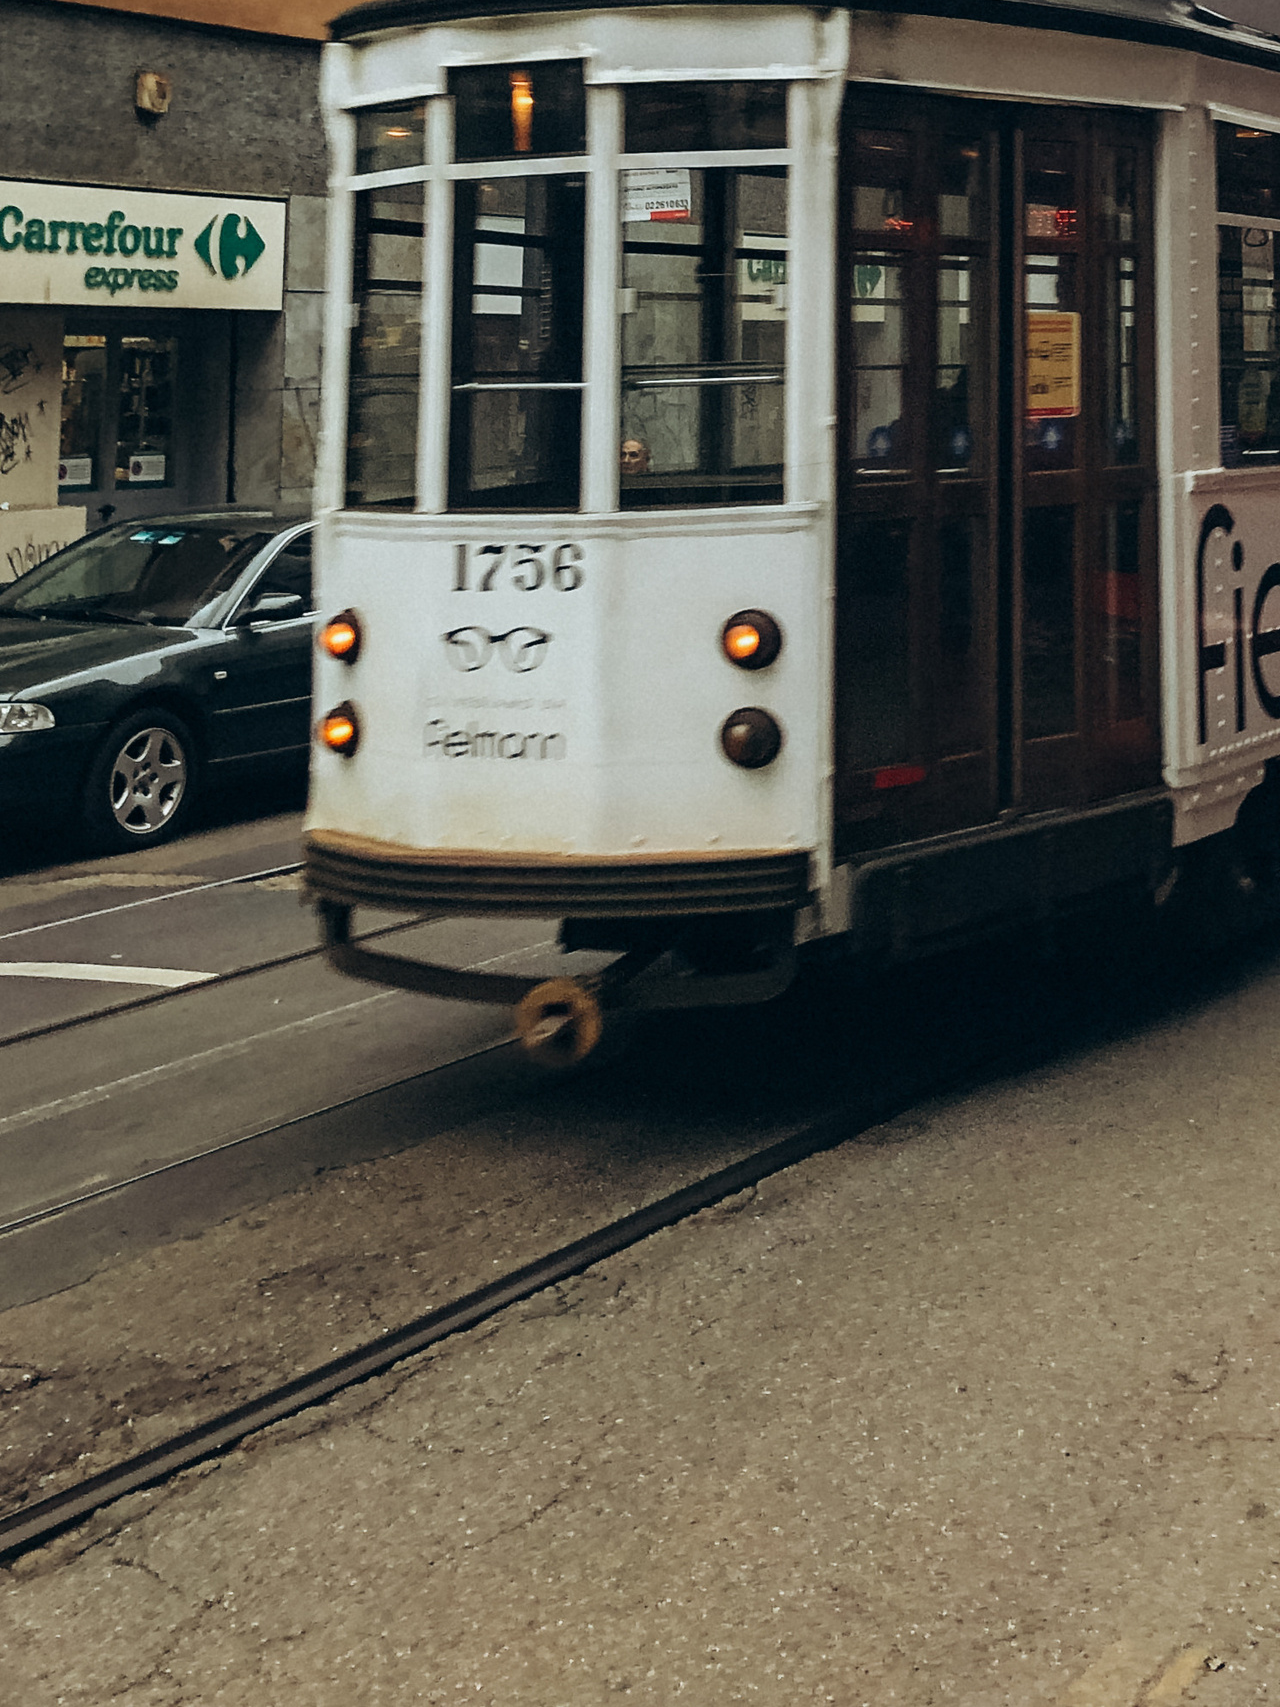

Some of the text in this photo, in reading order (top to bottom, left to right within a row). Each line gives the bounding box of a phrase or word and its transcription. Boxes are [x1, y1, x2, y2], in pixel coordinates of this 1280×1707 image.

[0, 205, 183, 258] Carrefour
[84, 266, 179, 297] express
[451, 543, 585, 592] 1756
